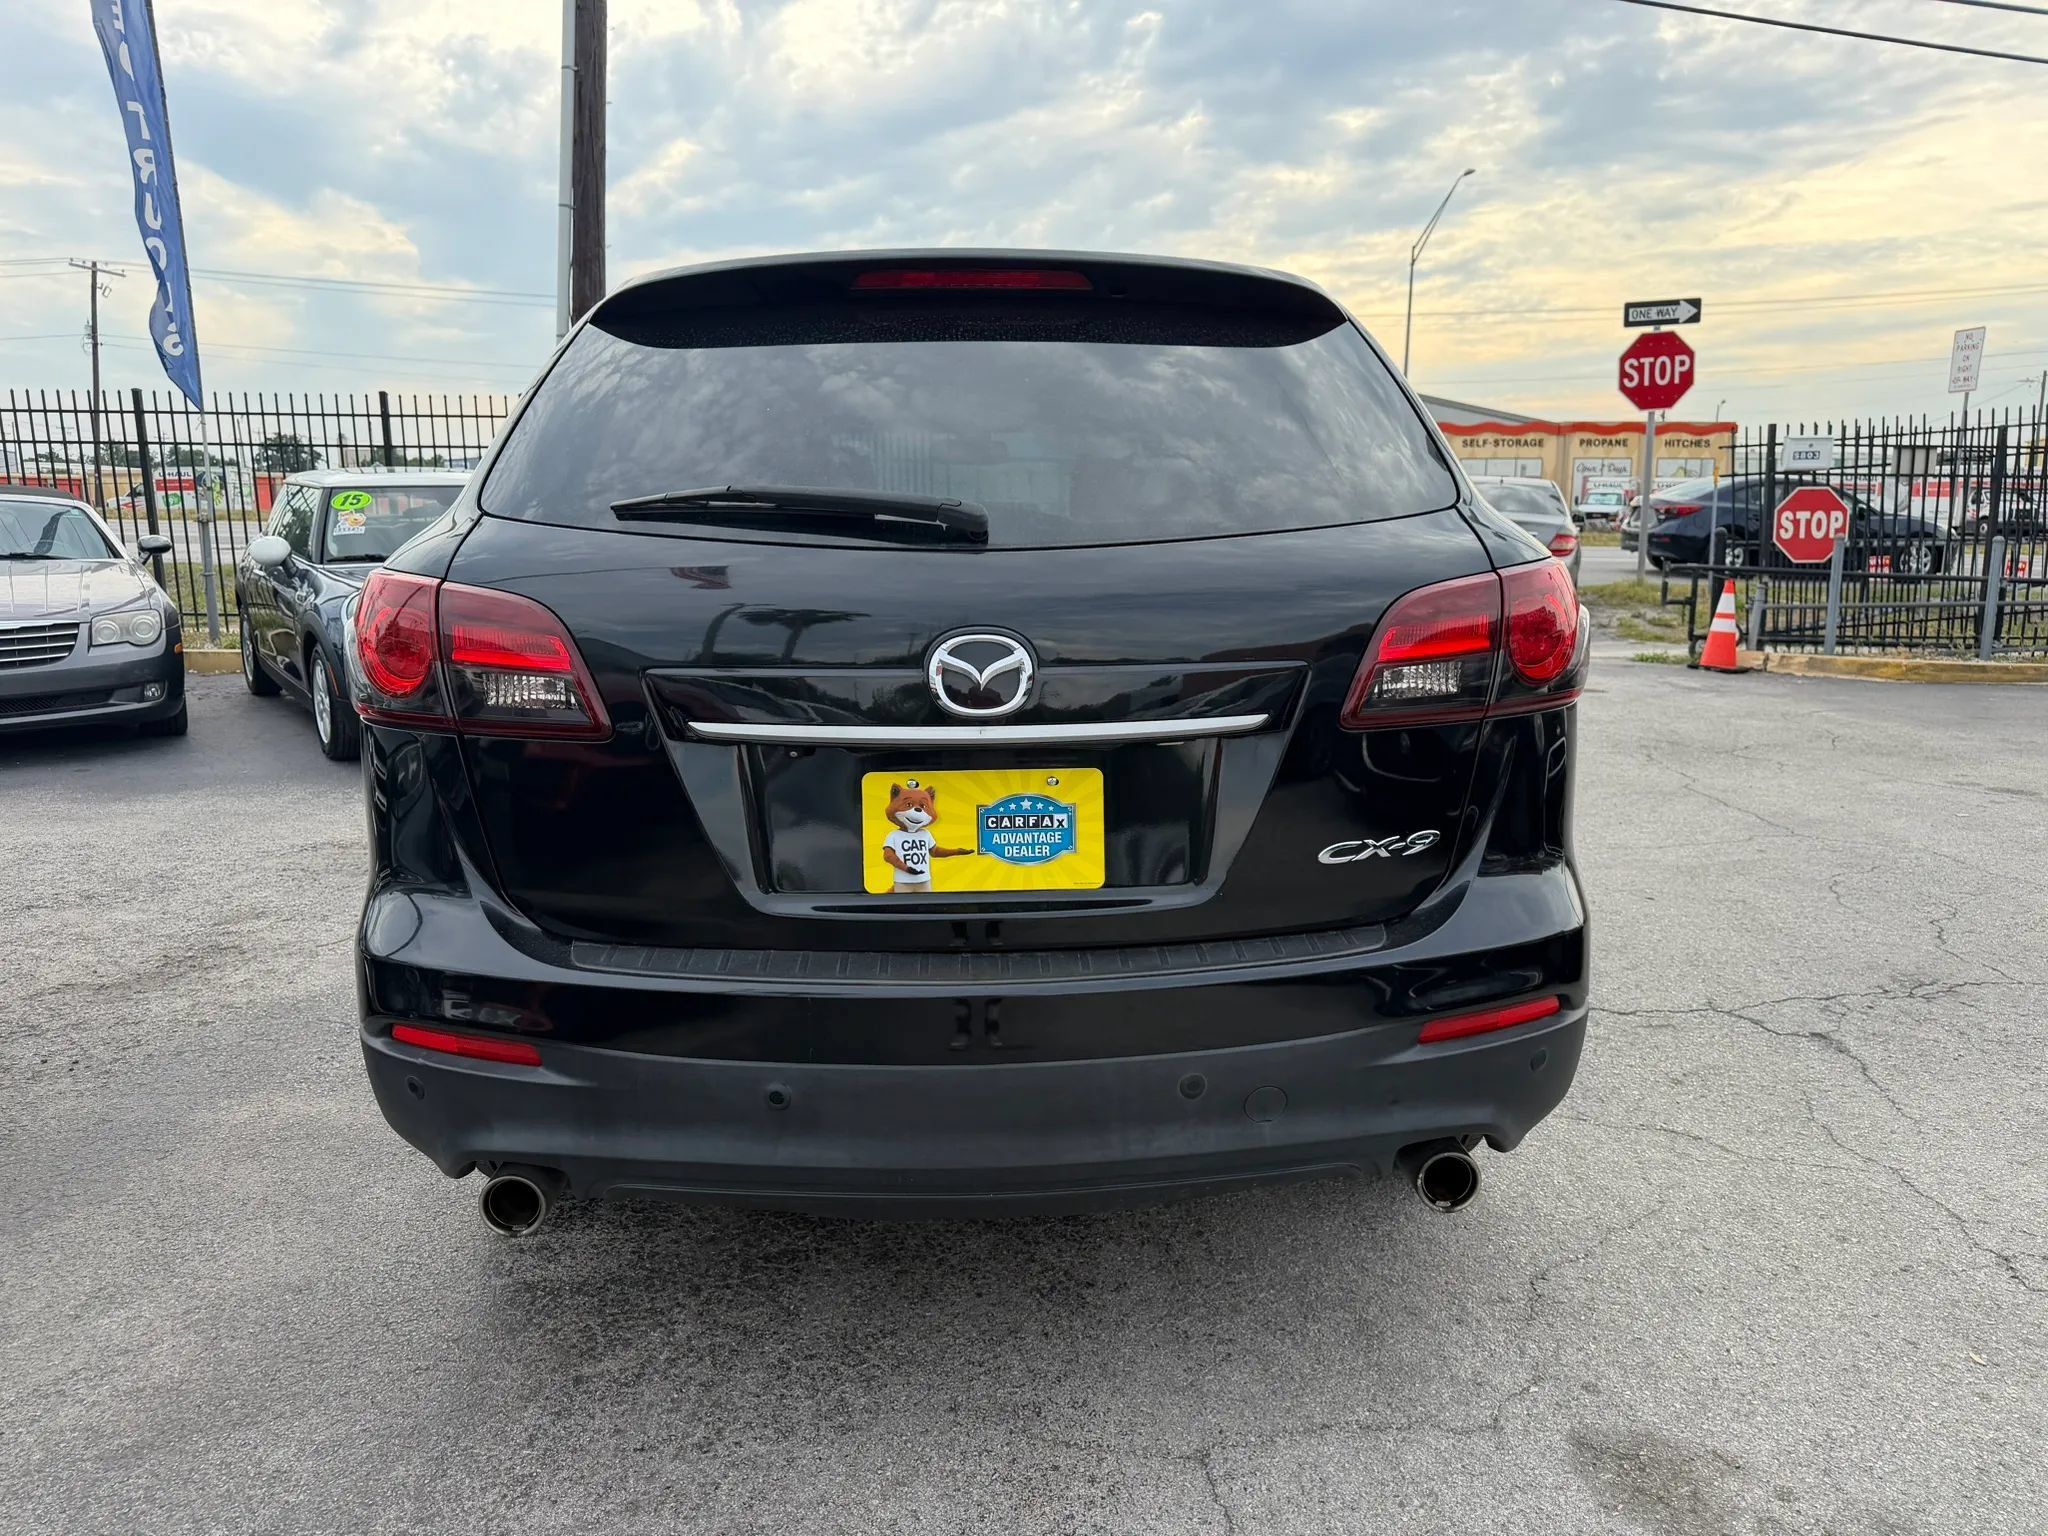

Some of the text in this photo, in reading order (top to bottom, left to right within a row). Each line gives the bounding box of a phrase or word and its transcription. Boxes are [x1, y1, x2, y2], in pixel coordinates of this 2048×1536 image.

[1631, 307, 1678, 320] ONE WAY
[1955, 343, 1980, 352] PARKING
[1623, 354, 1691, 389] STOP
[1462, 438, 1545, 448] SELF-STORAGE
[1579, 438, 1629, 448] PROPANE
[1664, 438, 1711, 449] HITCHES
[340, 494, 363, 506] 15
[1779, 510, 1844, 539] STOP
[986, 815, 1067, 829] CARFAX
[992, 831, 1062, 844] ADVANTAGE
[901, 839, 927, 852] CAR
[1004, 845, 1050, 857] DEALER
[1318, 830, 1440, 864] CX-9
[903, 852, 927, 865] FOX
